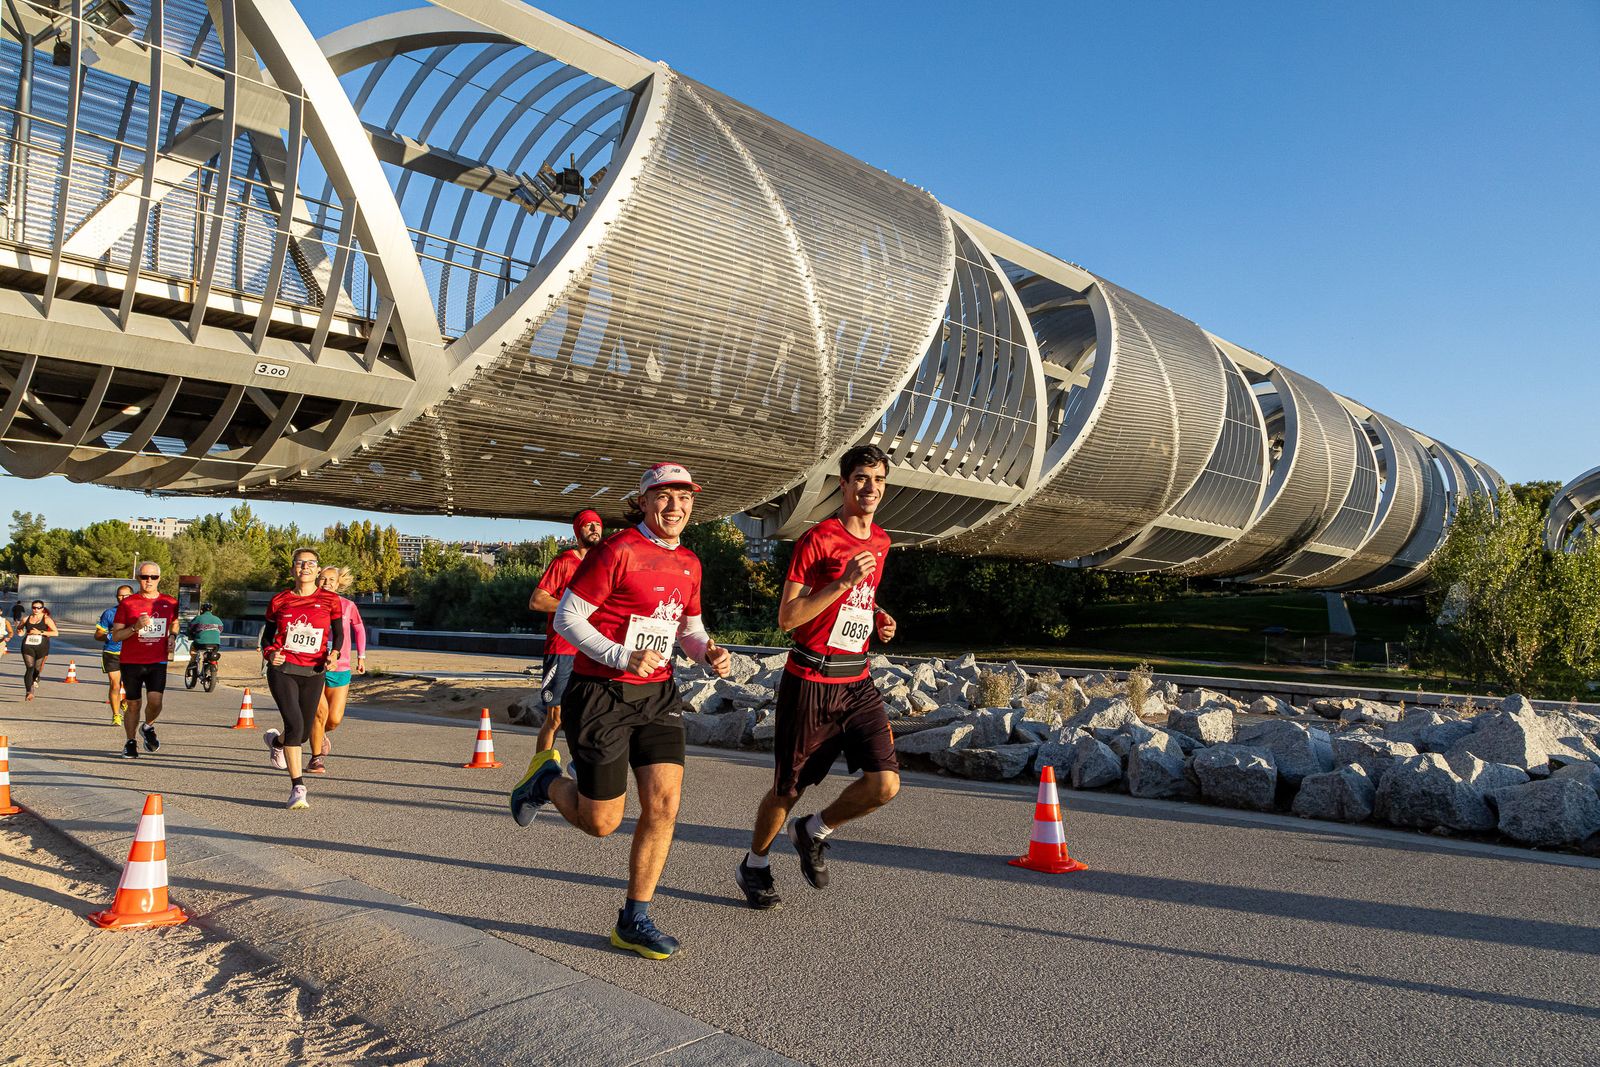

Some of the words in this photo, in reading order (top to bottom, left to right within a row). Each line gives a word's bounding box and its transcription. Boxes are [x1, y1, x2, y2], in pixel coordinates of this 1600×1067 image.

[258, 364, 286, 376] 3.00
[841, 620, 869, 640] 0836
[292, 633, 317, 647] 0319
[635, 632, 669, 654] 0205
